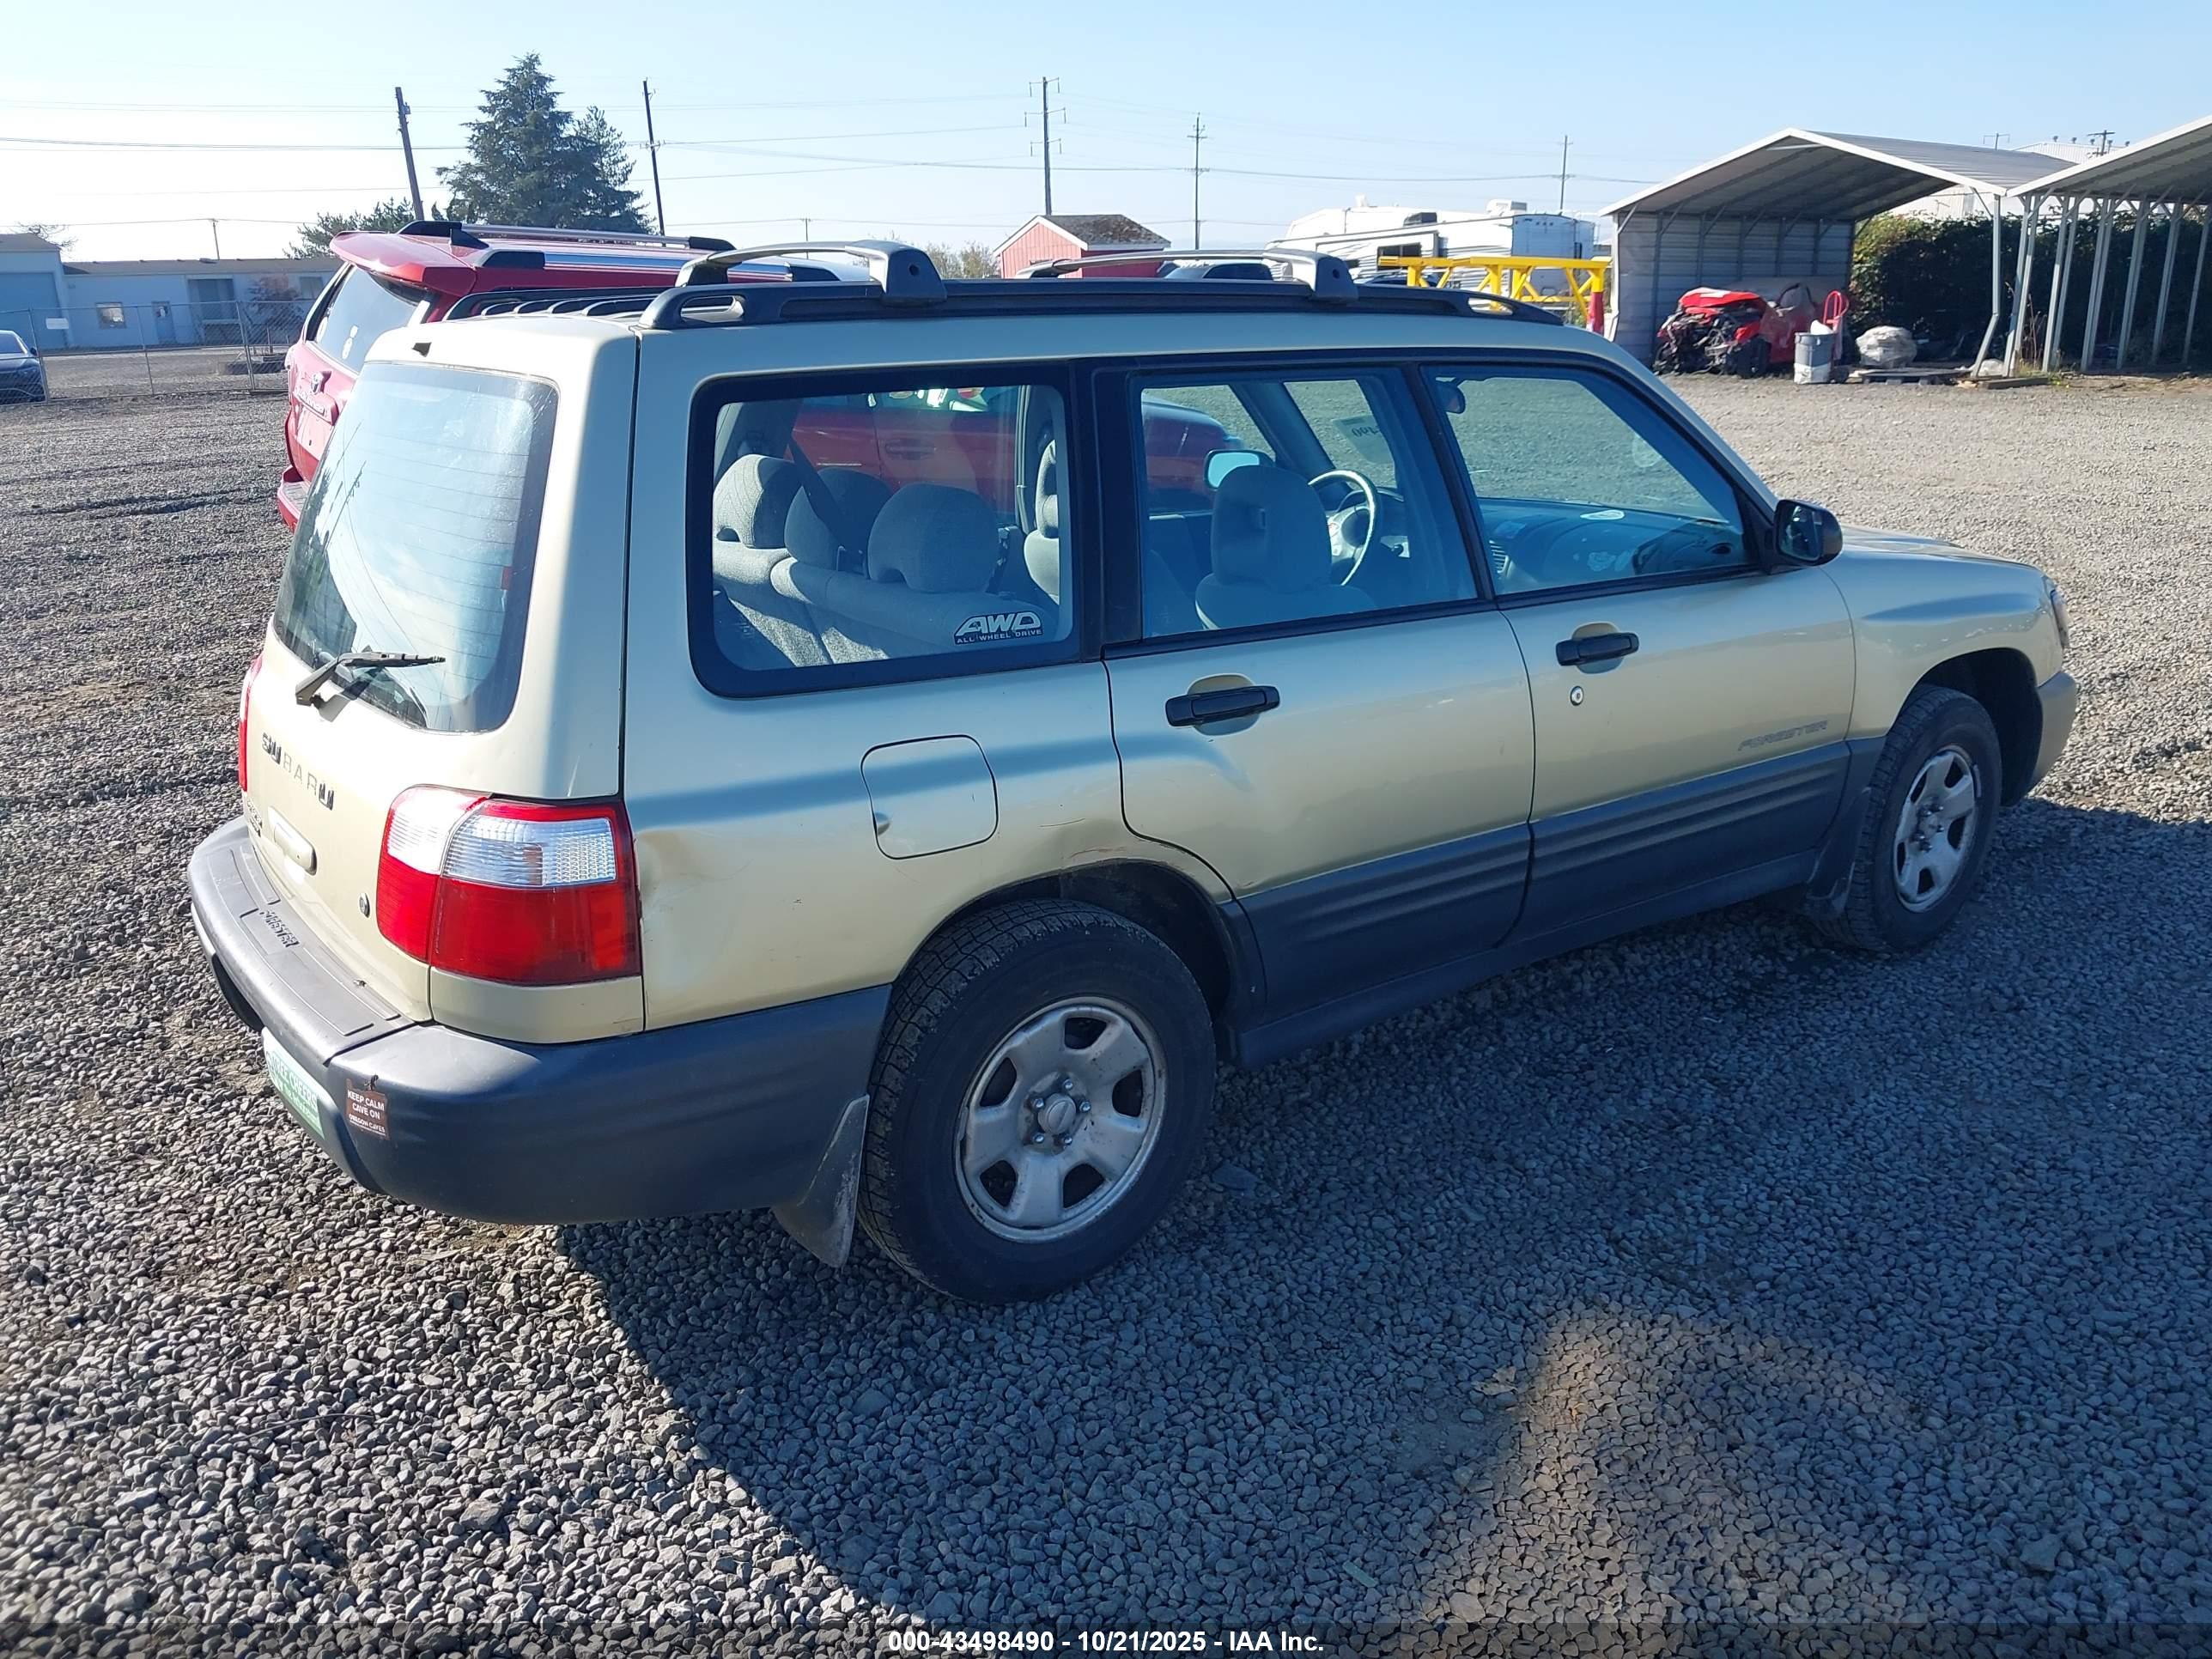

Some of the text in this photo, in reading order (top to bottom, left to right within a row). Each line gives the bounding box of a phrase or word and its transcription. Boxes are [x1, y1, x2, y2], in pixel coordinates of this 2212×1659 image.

[955, 611, 1042, 636] AWD
[979, 633, 1011, 641] WHEEL
[1015, 629, 1042, 637] DRIVE
[261, 732, 335, 811] SUBARU
[347, 1090, 385, 1111] KEEP CALM
[352, 1103, 380, 1120] CAVE ON
[349, 1113, 369, 1127] OREGON
[368, 1121, 386, 1133] CAVES
